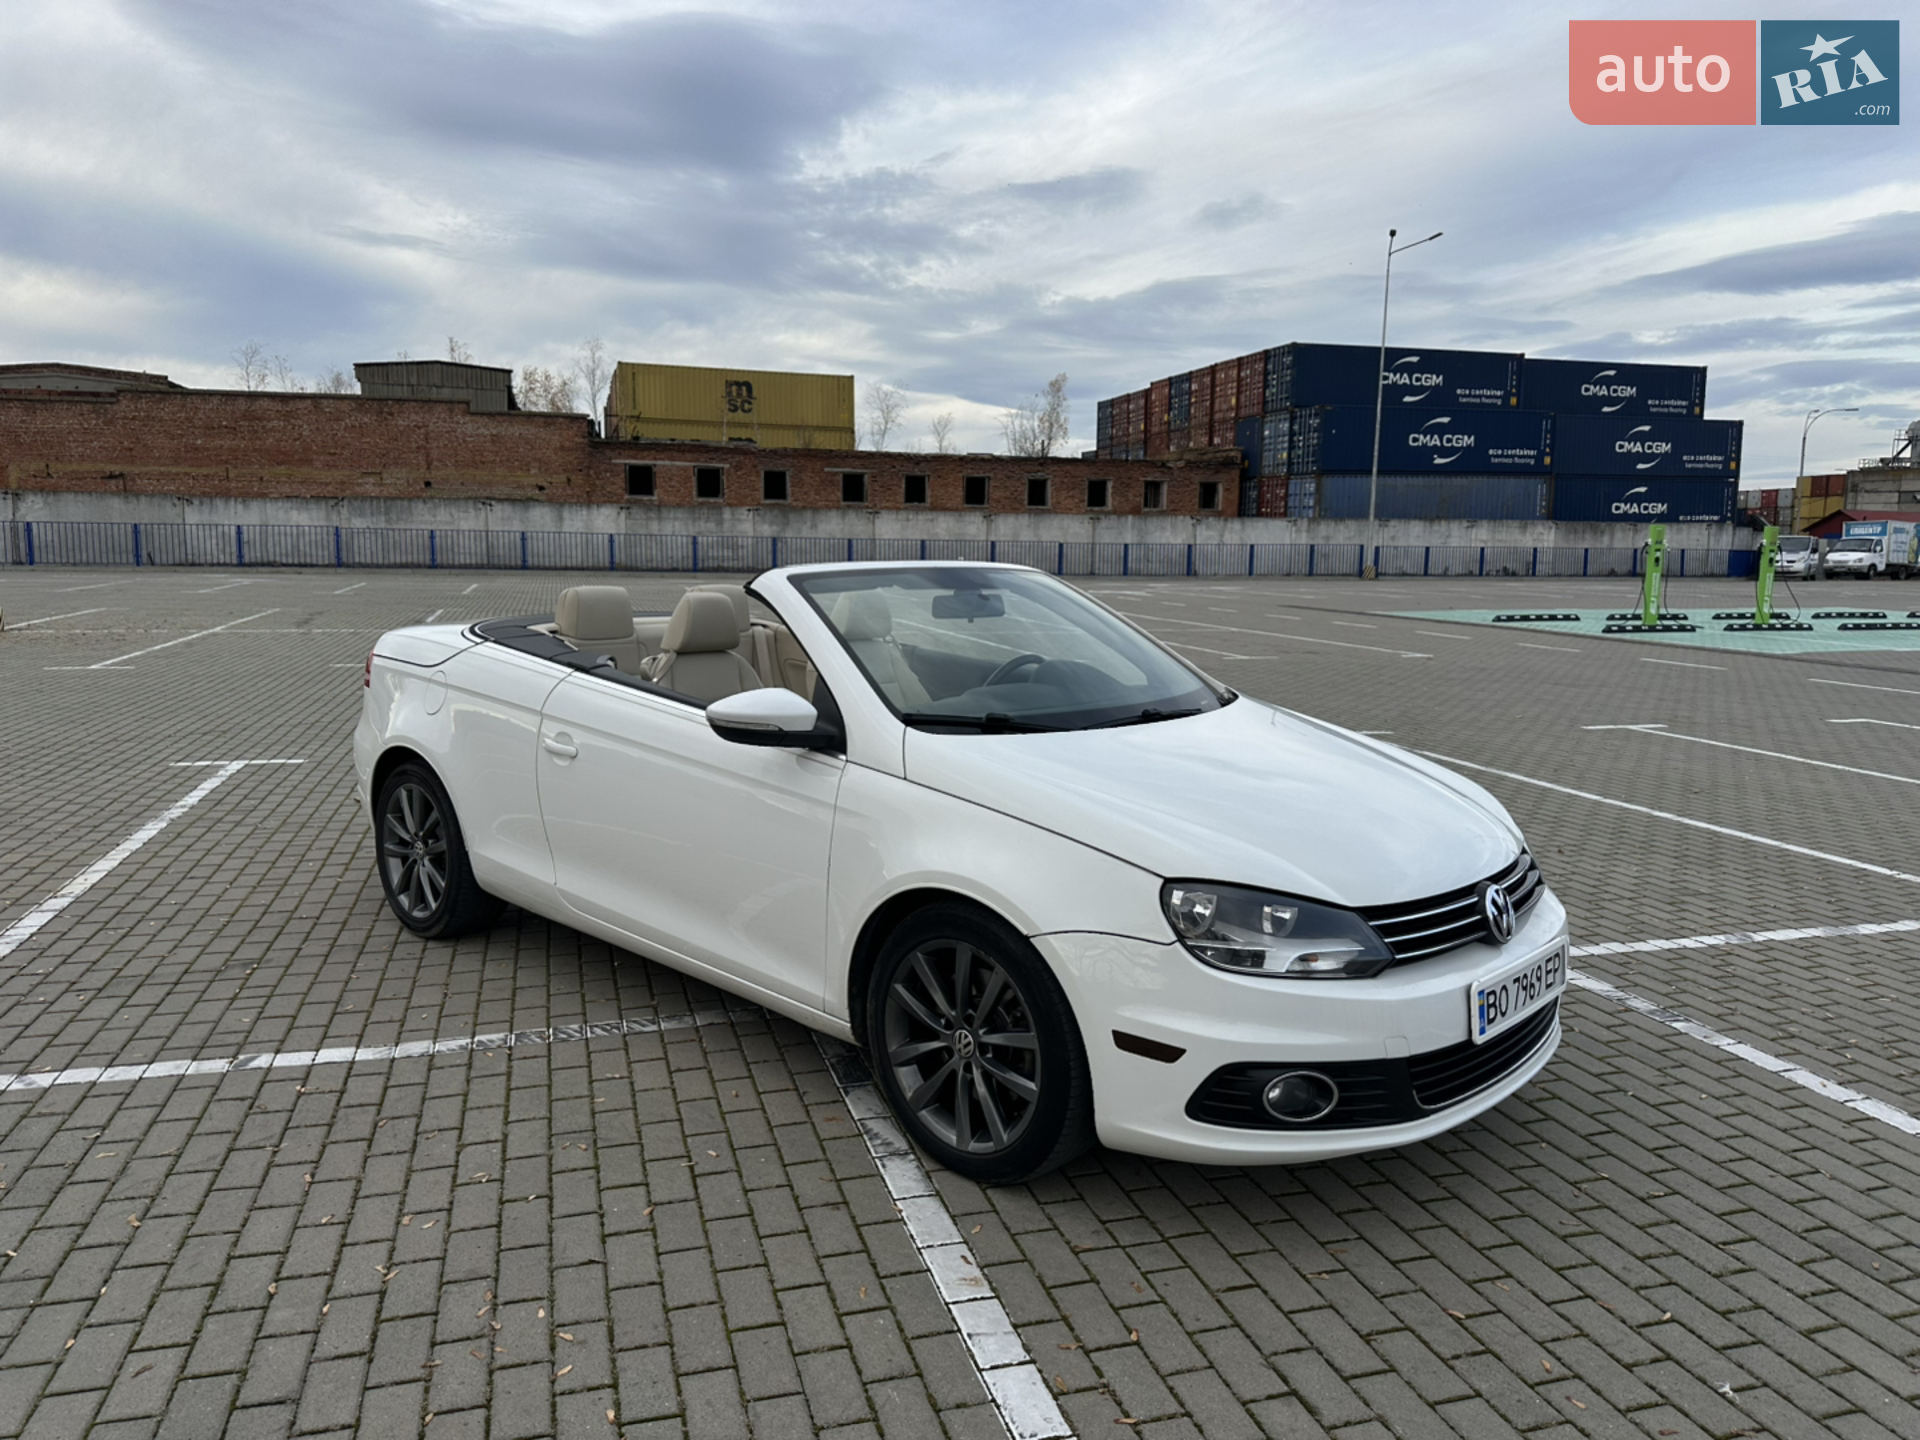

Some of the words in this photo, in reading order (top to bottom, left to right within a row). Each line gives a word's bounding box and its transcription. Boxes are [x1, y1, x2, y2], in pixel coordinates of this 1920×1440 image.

[1380, 371, 1410, 385] CMA
[1411, 373, 1444, 387] CGM
[1471, 387, 1505, 397] container
[1580, 383, 1609, 397] CMA
[1609, 385, 1637, 398] CGM
[1408, 433, 1441, 447] CMA
[1442, 434, 1475, 448] CGM
[1615, 440, 1643, 453] CMA
[1644, 441, 1672, 454] CGM
[1503, 448, 1538, 457] container
[1611, 501, 1639, 514] CMA
[1640, 502, 1668, 515] CGM
[1513, 964, 1543, 1012] 7969
